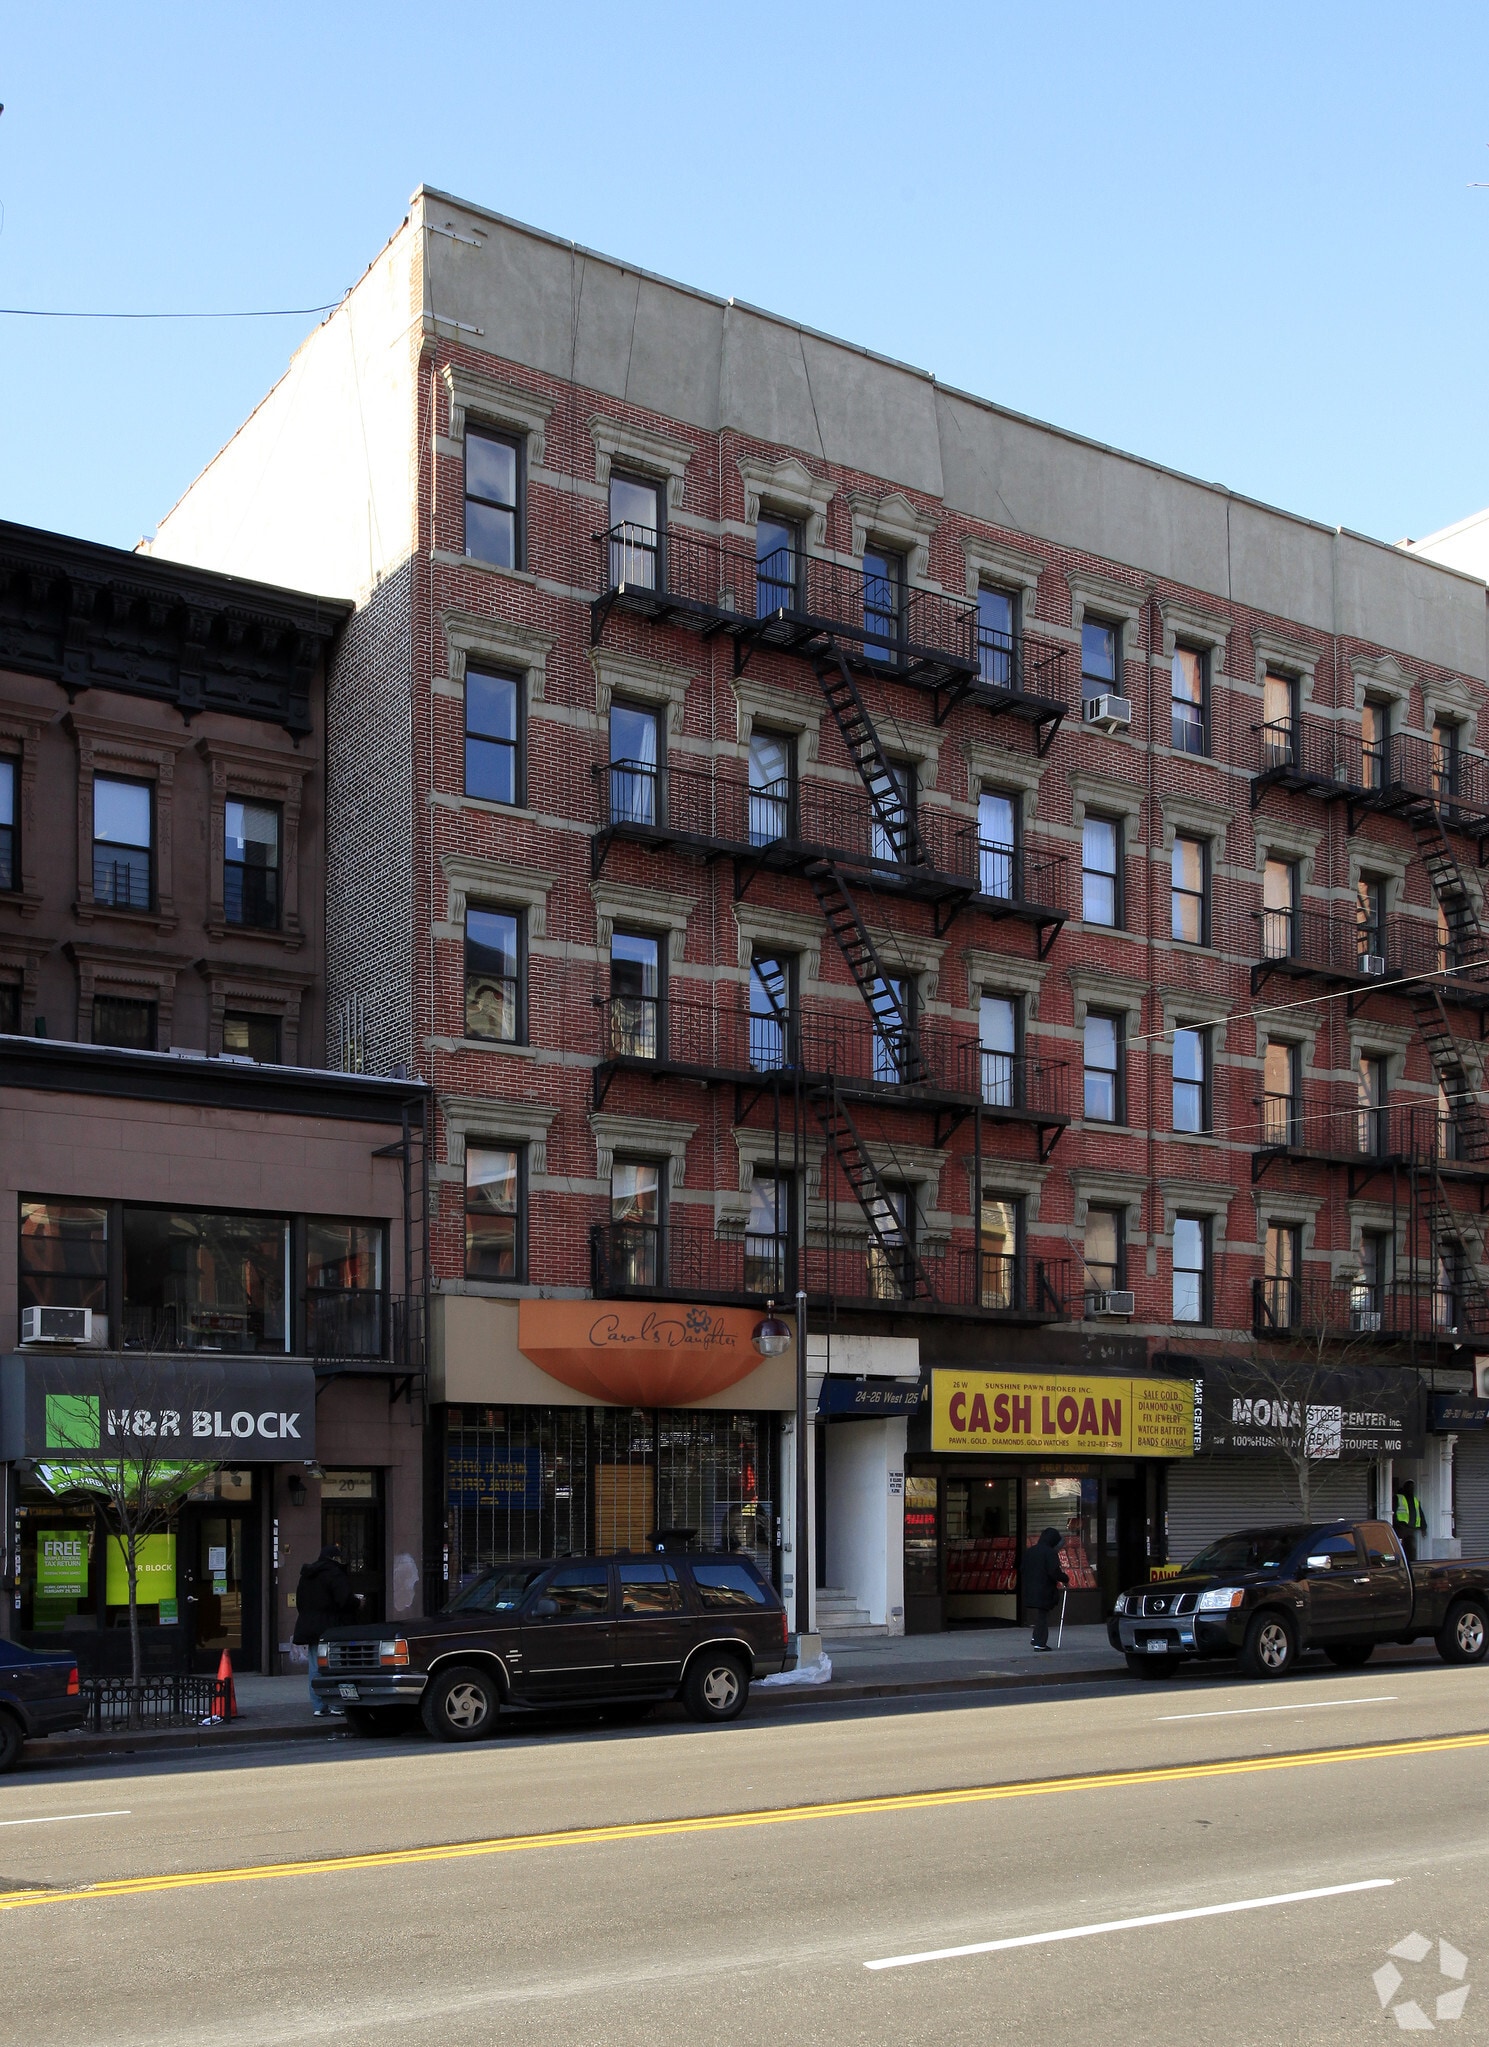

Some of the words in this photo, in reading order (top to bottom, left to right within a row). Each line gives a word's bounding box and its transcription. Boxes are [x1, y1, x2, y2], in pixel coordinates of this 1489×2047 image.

[653, 1318, 738, 1350] Daughter
[985, 1382, 1020, 1390] SUNSHINE
[855, 1391, 881, 1403] 24-26
[883, 1392, 903, 1403] West
[904, 1392, 919, 1404] 125
[1143, 1389, 1158, 1400] SALE
[1160, 1391, 1178, 1400] GOLD
[1194, 1380, 1203, 1405] HAIR
[1138, 1402, 1168, 1411] DIAMOND
[1171, 1403, 1183, 1412] AND
[949, 1391, 1032, 1434] CASH
[1041, 1395, 1122, 1436] LOAN
[1143, 1413, 1152, 1422] FIX
[1155, 1414, 1180, 1423] JEWELRY
[1307, 1408, 1339, 1421] STORE
[1341, 1412, 1387, 1426] CENTER
[107, 1408, 181, 1437] H&R
[192, 1410, 301, 1438] BLOCK
[1138, 1425, 1158, 1434] WATCH
[1160, 1426, 1187, 1435] BATTERY
[1194, 1408, 1203, 1451] CENTER
[1043, 1439, 1069, 1447] WATCHES
[1138, 1437, 1158, 1446] BANDS
[1160, 1438, 1186, 1447] CHANGE
[1384, 1440, 1402, 1450] WIG
[339, 1479, 355, 1491] 20
[44, 1541, 82, 1556] FREE
[145, 1564, 172, 1572] BLOCK
